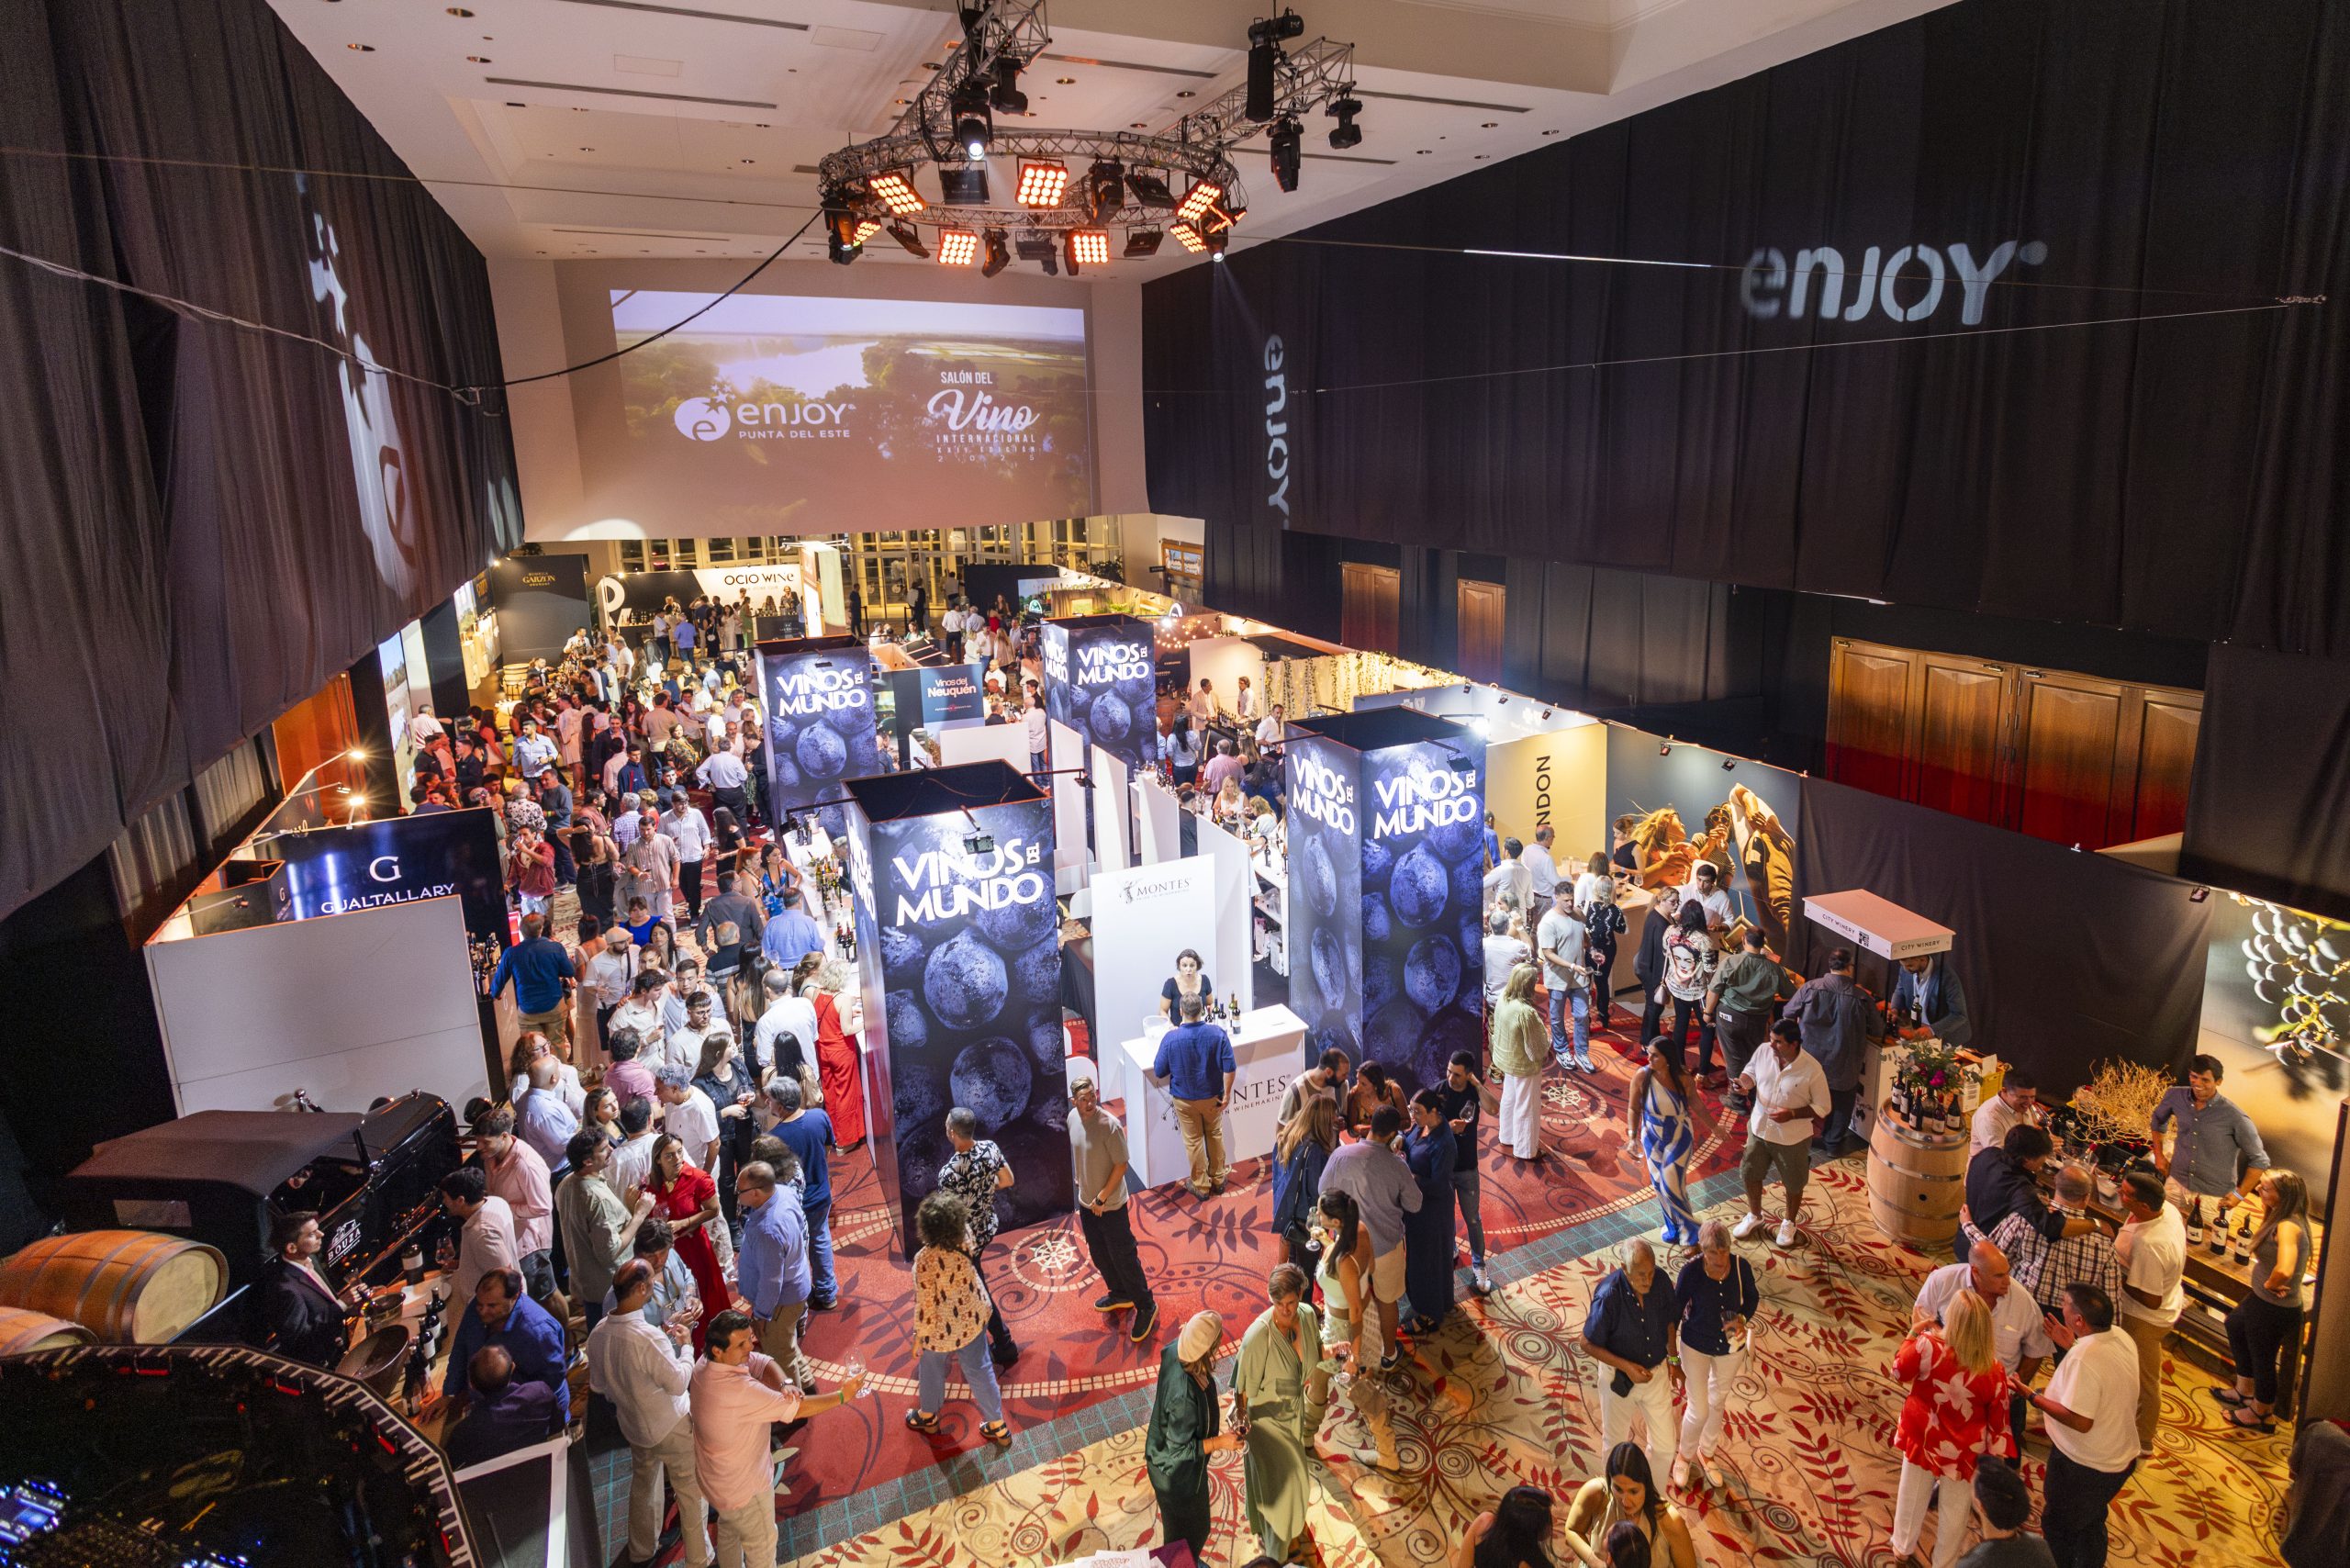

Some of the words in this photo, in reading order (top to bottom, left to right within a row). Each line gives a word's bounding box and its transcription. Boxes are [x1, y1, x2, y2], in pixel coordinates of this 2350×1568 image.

[940, 370, 973, 384] SALÓN
[975, 372, 993, 385] DEL
[927, 388, 1040, 431] Vino
[739, 430, 785, 439] PUNTA
[789, 430, 814, 439] DEL
[820, 429, 850, 438] ESTE
[936, 434, 1035, 442] INTERNACIONAL
[724, 574, 759, 586] OCIO
[1077, 643, 1140, 667] VINOS
[776, 668, 854, 697] VINOS
[934, 679, 956, 688] Vinos
[956, 678, 968, 686] del
[1078, 661, 1149, 686] MUNDO
[778, 689, 867, 717] MUNDO
[927, 683, 977, 698] Neuquén
[1292, 754, 1346, 804] VINOS
[1374, 769, 1465, 810] VINOS
[1465, 769, 1476, 788] DEL
[1292, 783, 1355, 835] MUNDO
[1373, 795, 1477, 839] MUNDO
[369, 856, 402, 882] G
[892, 838, 1024, 891] VINOS
[1026, 842, 1040, 865] DEL
[320, 883, 455, 914] GUALTALLARY
[896, 872, 1044, 927] MUNDO
[1136, 879, 1190, 897] MONTES
[1917, 940, 1941, 948] WINERY
[1233, 1075, 1286, 1104] NTES
[328, 1227, 361, 1261] BOUZA
